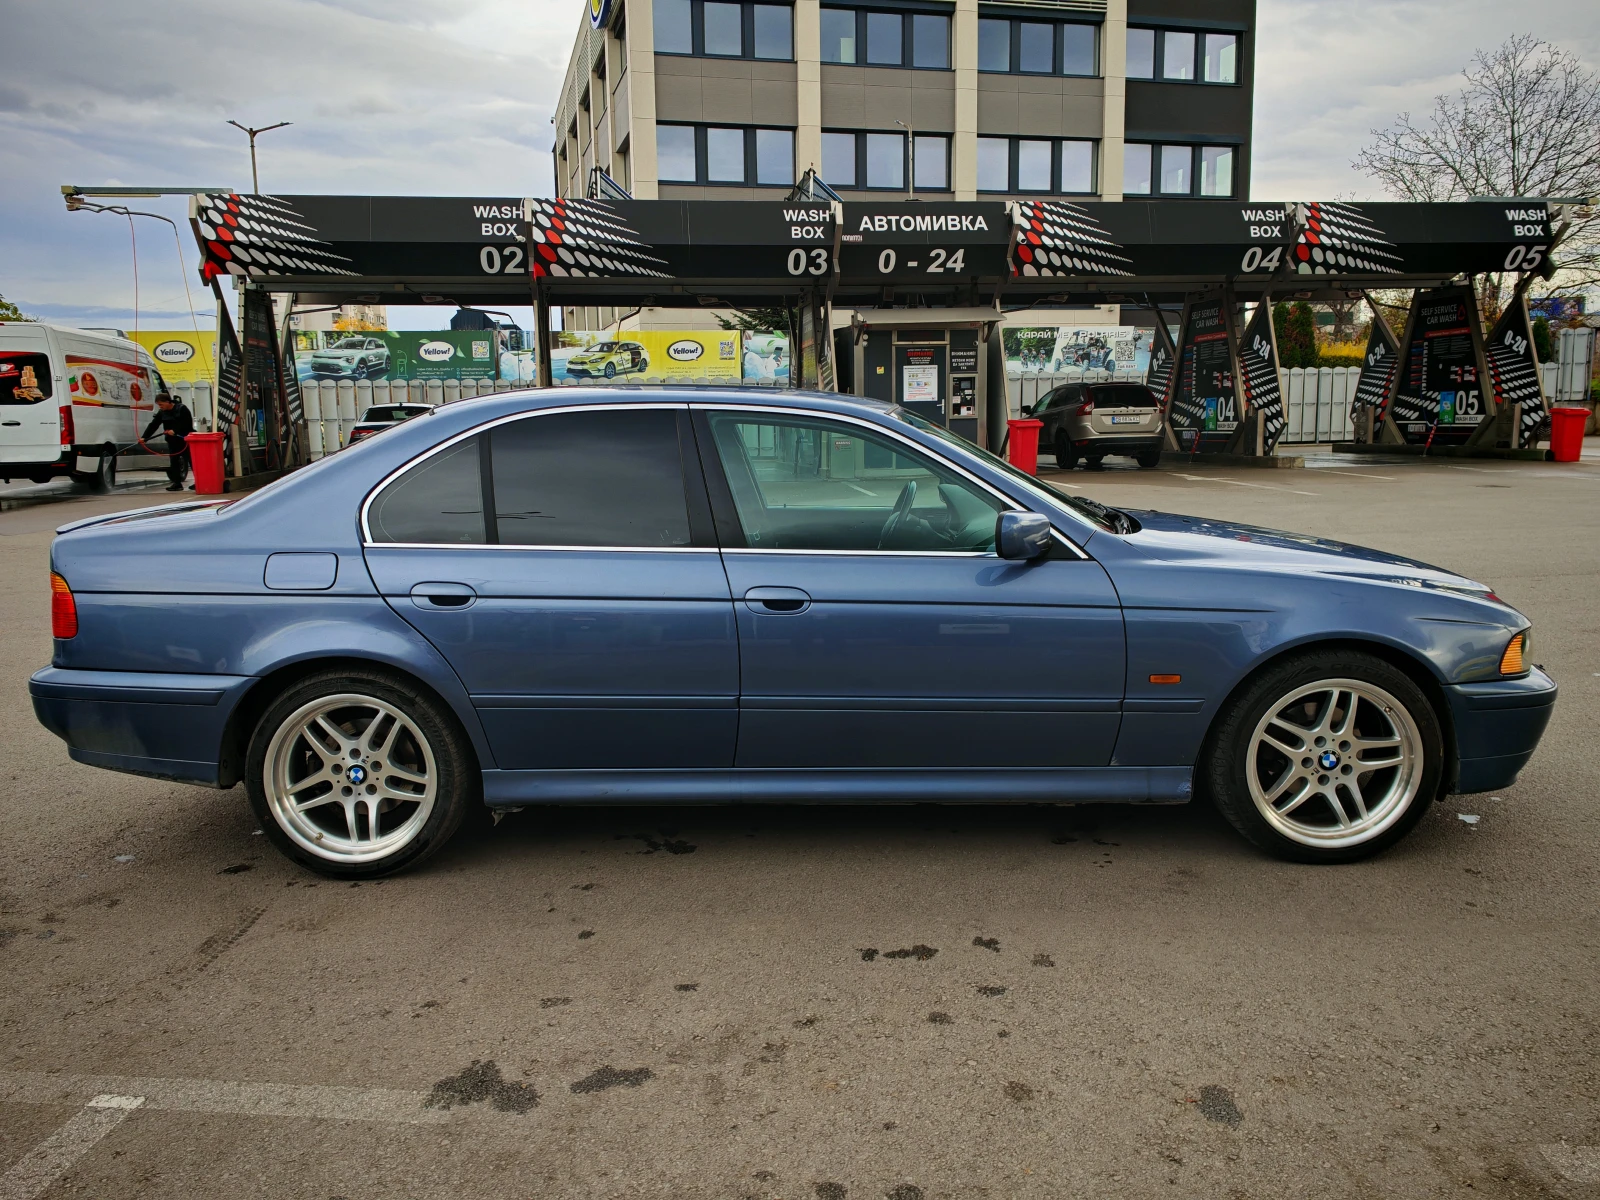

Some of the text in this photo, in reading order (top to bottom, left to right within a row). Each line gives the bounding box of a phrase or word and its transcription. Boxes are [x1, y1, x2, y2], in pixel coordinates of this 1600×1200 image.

[473, 206, 523, 219] WASH
[783, 209, 830, 222] WASH
[1241, 210, 1285, 221] WASH
[1505, 209, 1547, 221] WASH
[481, 223, 518, 236] BOX
[859, 215, 989, 231] АВТОМИВКА
[791, 226, 825, 239] BOX
[1250, 226, 1282, 237] BOX
[1514, 224, 1545, 236] BOX
[480, 246, 525, 274] 02
[787, 248, 828, 276] 03
[878, 249, 897, 274] 0
[926, 248, 965, 273] 24
[1241, 246, 1283, 272] 04
[1503, 245, 1548, 270] 05
[1421, 303, 1458, 316] SELF SERVICE
[1195, 317, 1219, 328] CAR WASH
[1426, 313, 1457, 325] CAR WASH
[1017, 329, 1051, 339] КАРАЙ
[1253, 334, 1271, 360] 0-24
[1504, 329, 1528, 355] 0-24
[160, 348, 188, 356] Yellow!
[423, 347, 451, 356] Yellow!
[673, 346, 699, 355] Yellow!
[1368, 342, 1386, 366] 0-24
[1152, 347, 1166, 372] 0-24
[1217, 396, 1235, 421] 04
[1456, 390, 1479, 415] 05
[246, 409, 257, 436] 02
